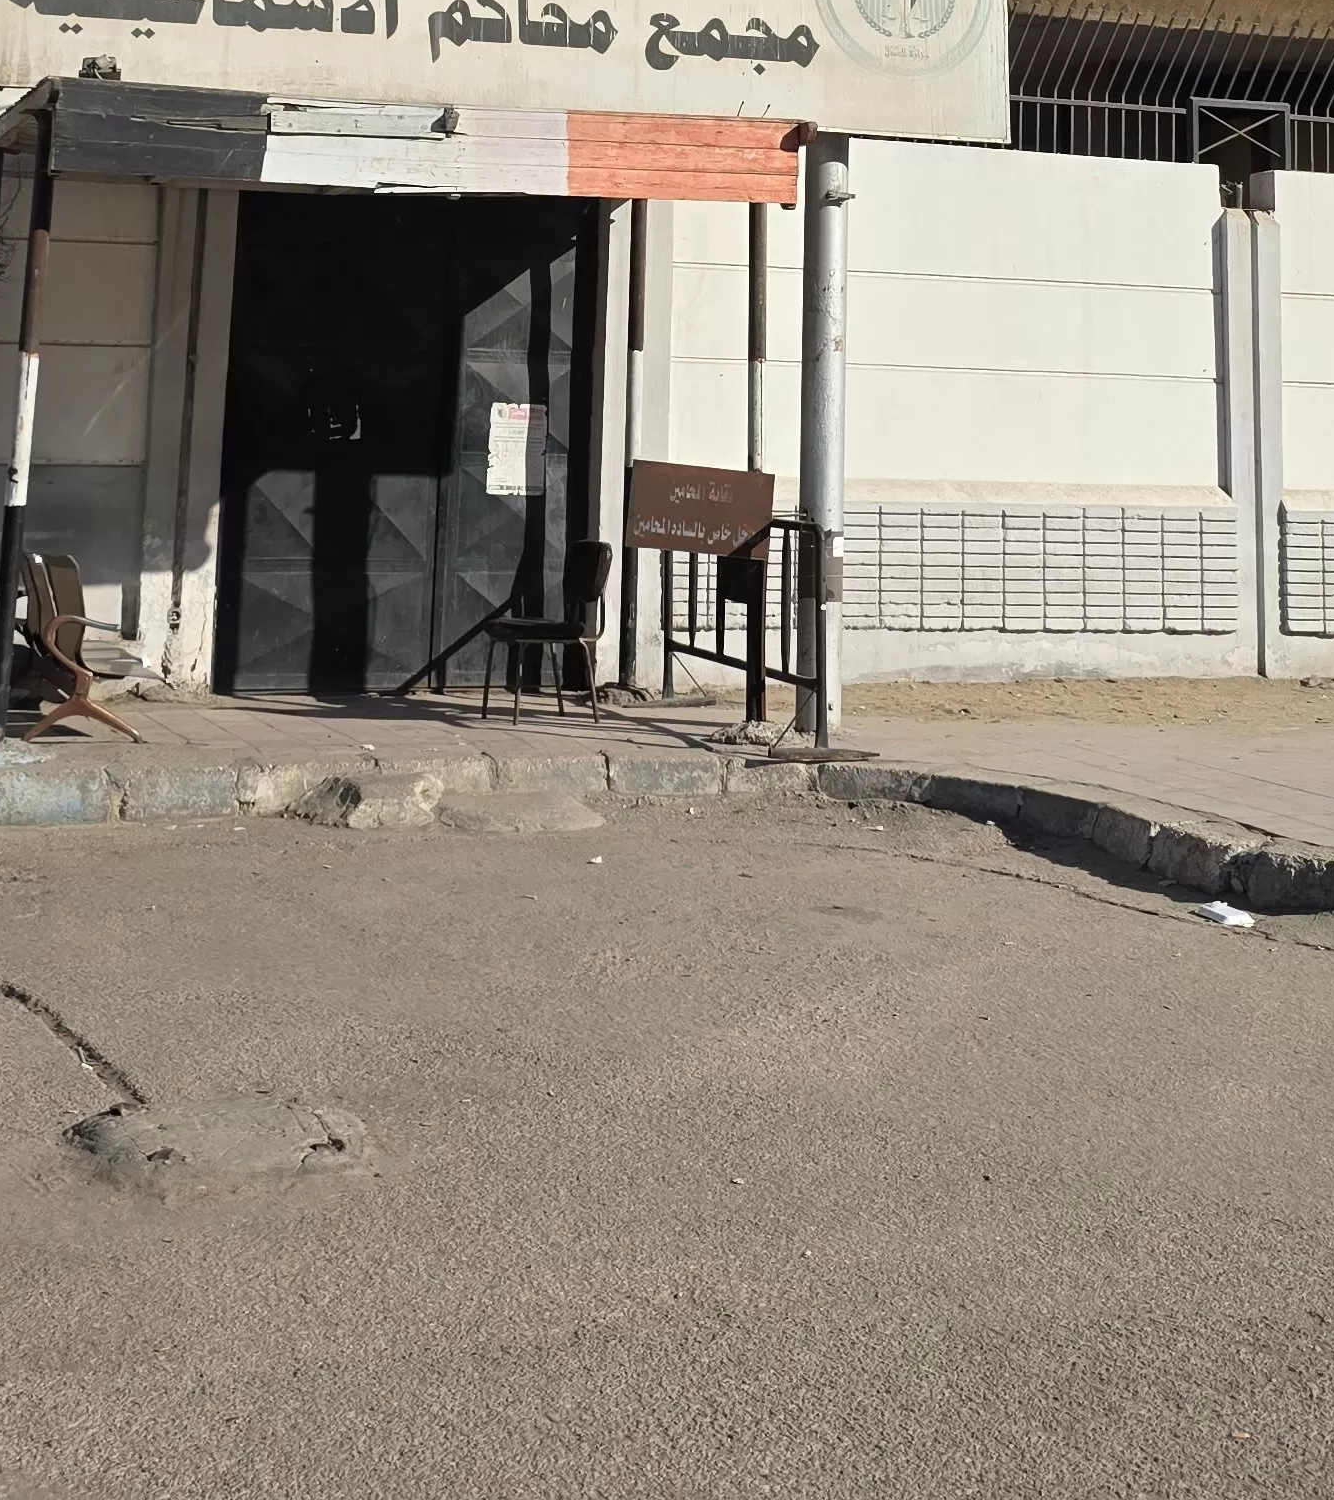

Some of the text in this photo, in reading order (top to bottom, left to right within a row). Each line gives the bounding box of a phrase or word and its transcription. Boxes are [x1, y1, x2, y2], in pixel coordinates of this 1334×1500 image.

[644, 12, 821, 76] مجمع
[669, 483, 706, 504] المحامين
[633, 514, 671, 538] المحامين
[707, 522, 732, 545] خاص
